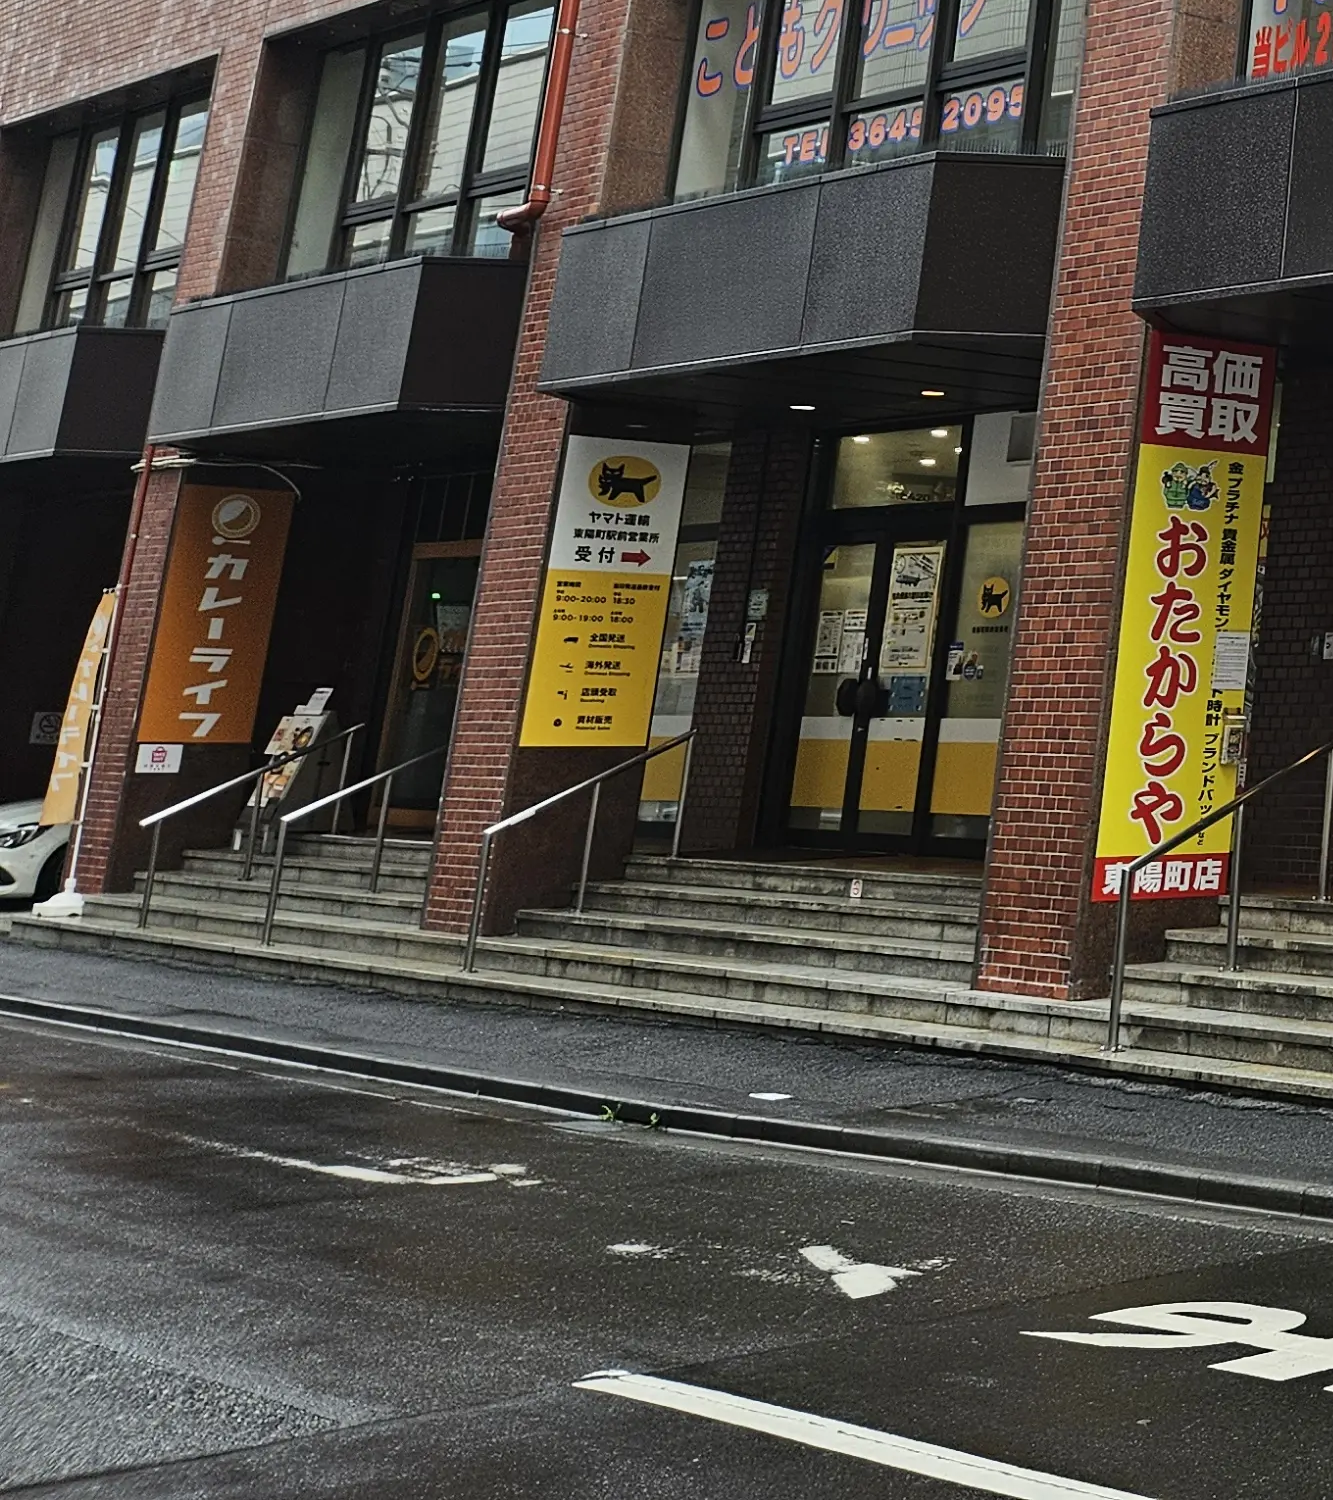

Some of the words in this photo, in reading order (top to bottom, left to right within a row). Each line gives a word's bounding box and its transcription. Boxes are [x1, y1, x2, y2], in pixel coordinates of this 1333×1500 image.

[940, 78, 1026, 134] 2095
[1160, 344, 1263, 399] 高価
[1154, 393, 1261, 444] 買取
[1227, 461, 1245, 476] 金
[574, 545, 616, 564] 受付
[1219, 527, 1238, 566] 貴金属
[1214, 568, 1234, 631] ダイヤモン
[178, 553, 250, 738] カレーライフ
[1128, 513, 1210, 847] おたからや
